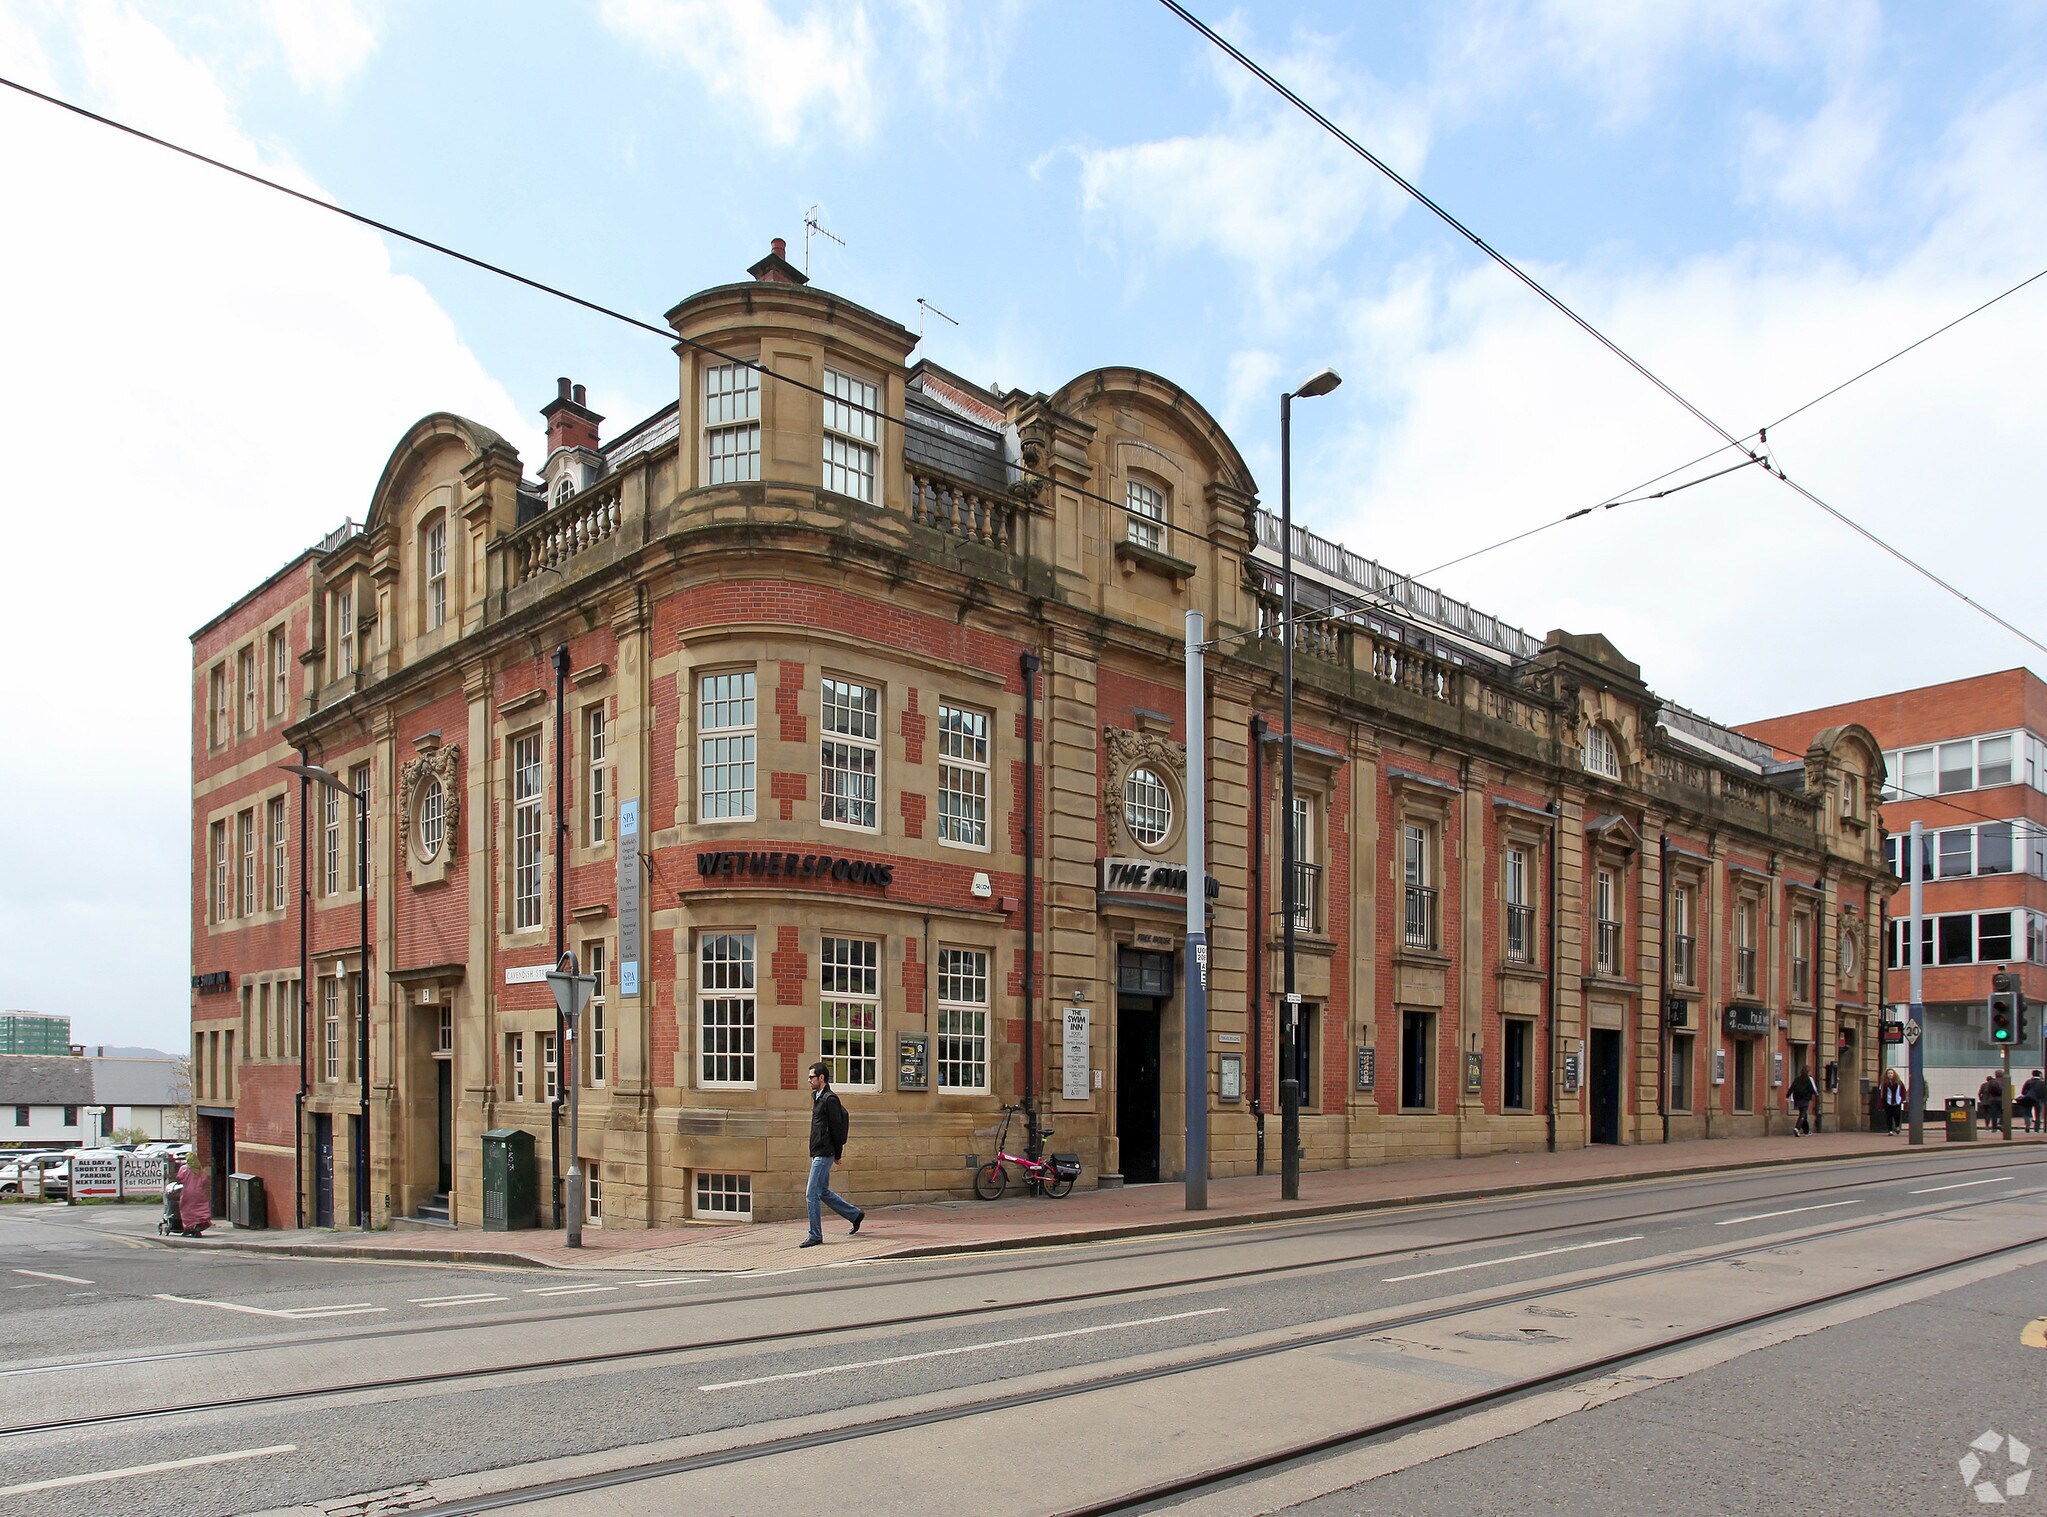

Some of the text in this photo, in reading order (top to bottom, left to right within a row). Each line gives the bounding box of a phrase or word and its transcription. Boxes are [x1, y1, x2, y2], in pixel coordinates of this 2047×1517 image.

[1486, 691, 1541, 732] PUBLIC
[622, 812, 635, 823] SPA
[697, 851, 894, 886] WETHERSPOONS
[1109, 864, 1151, 885] THE
[507, 970, 534, 980] CAVENDISH
[623, 971, 635, 982] SPA
[1067, 1015, 1086, 1024] SWIM
[1070, 1023, 1083, 1031] INN
[1906, 1026, 1919, 1037] 20
[124, 1160, 162, 1169] ALL DAY
[124, 1169, 162, 1178] PARKING
